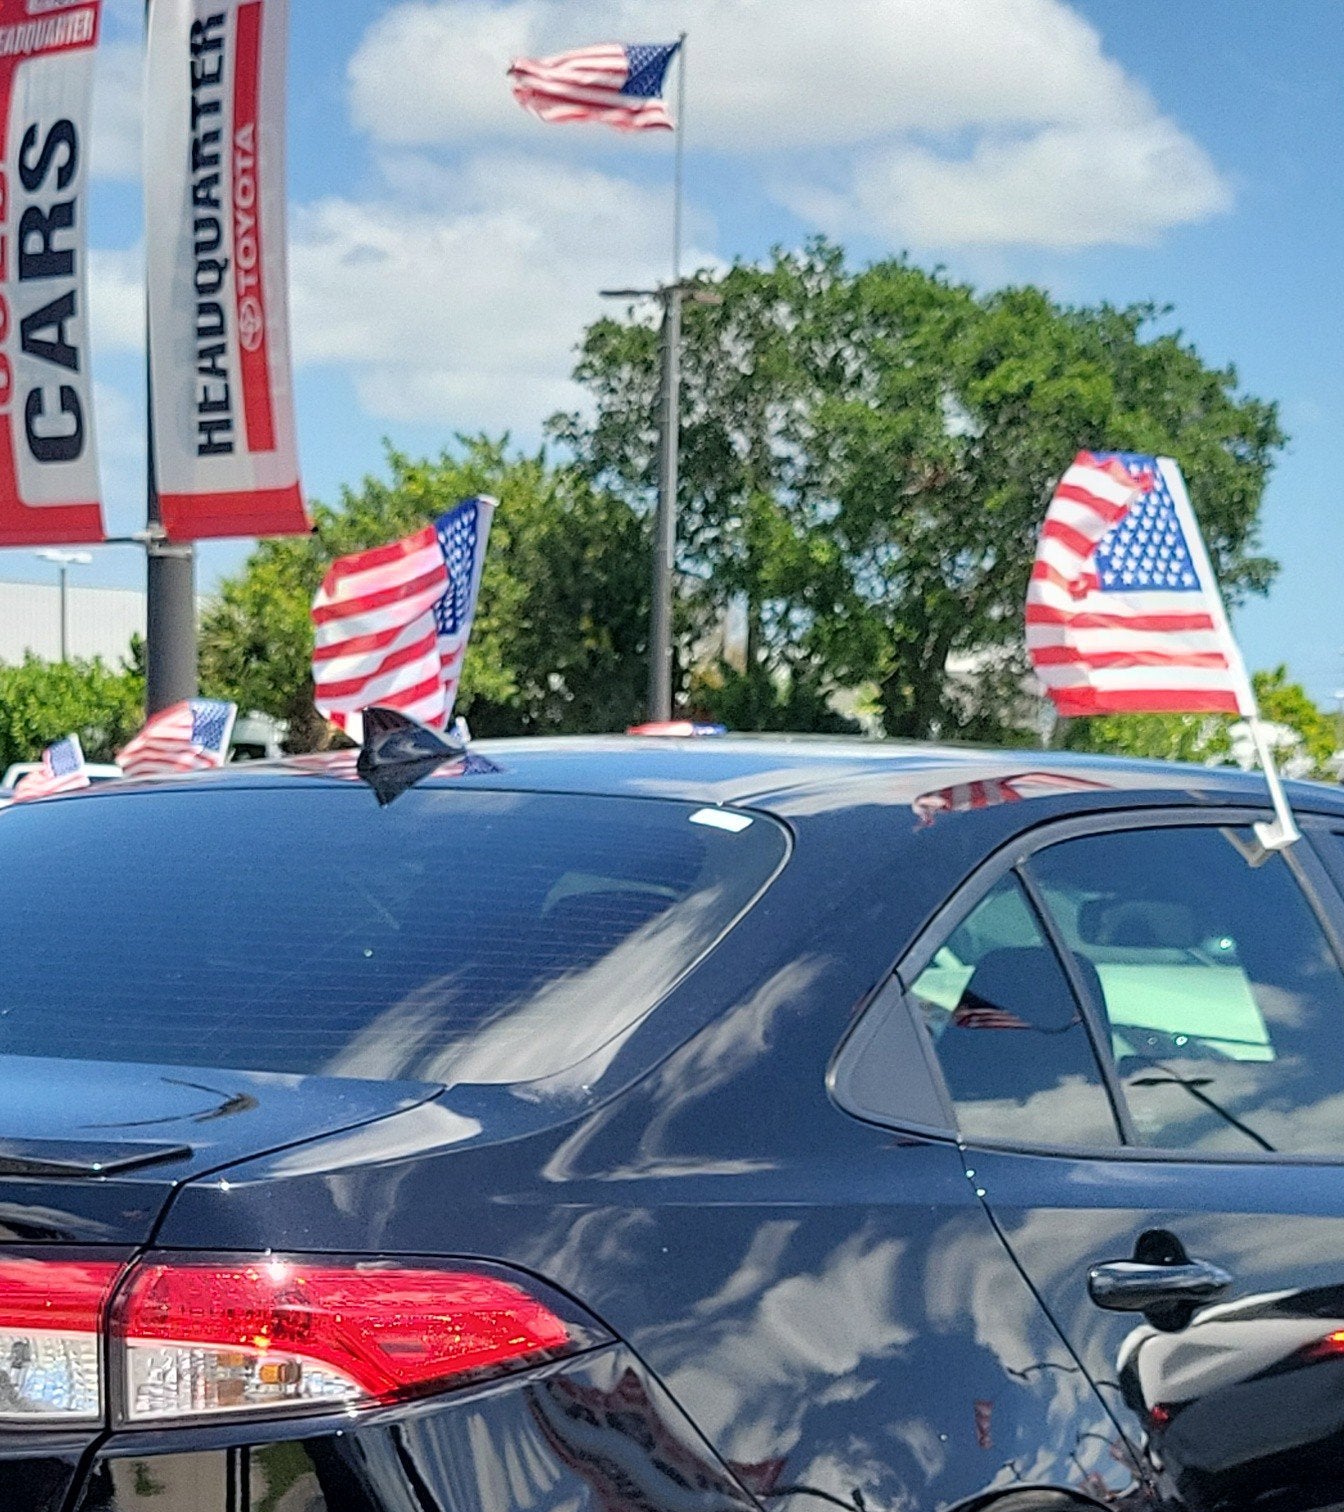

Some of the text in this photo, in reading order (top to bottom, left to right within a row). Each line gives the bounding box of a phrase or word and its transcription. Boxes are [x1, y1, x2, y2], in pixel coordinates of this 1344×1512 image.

[19, 119, 84, 462] CARS
[190, 13, 233, 456] HEADQUARTER
[235, 123, 258, 296] TOYOTA
